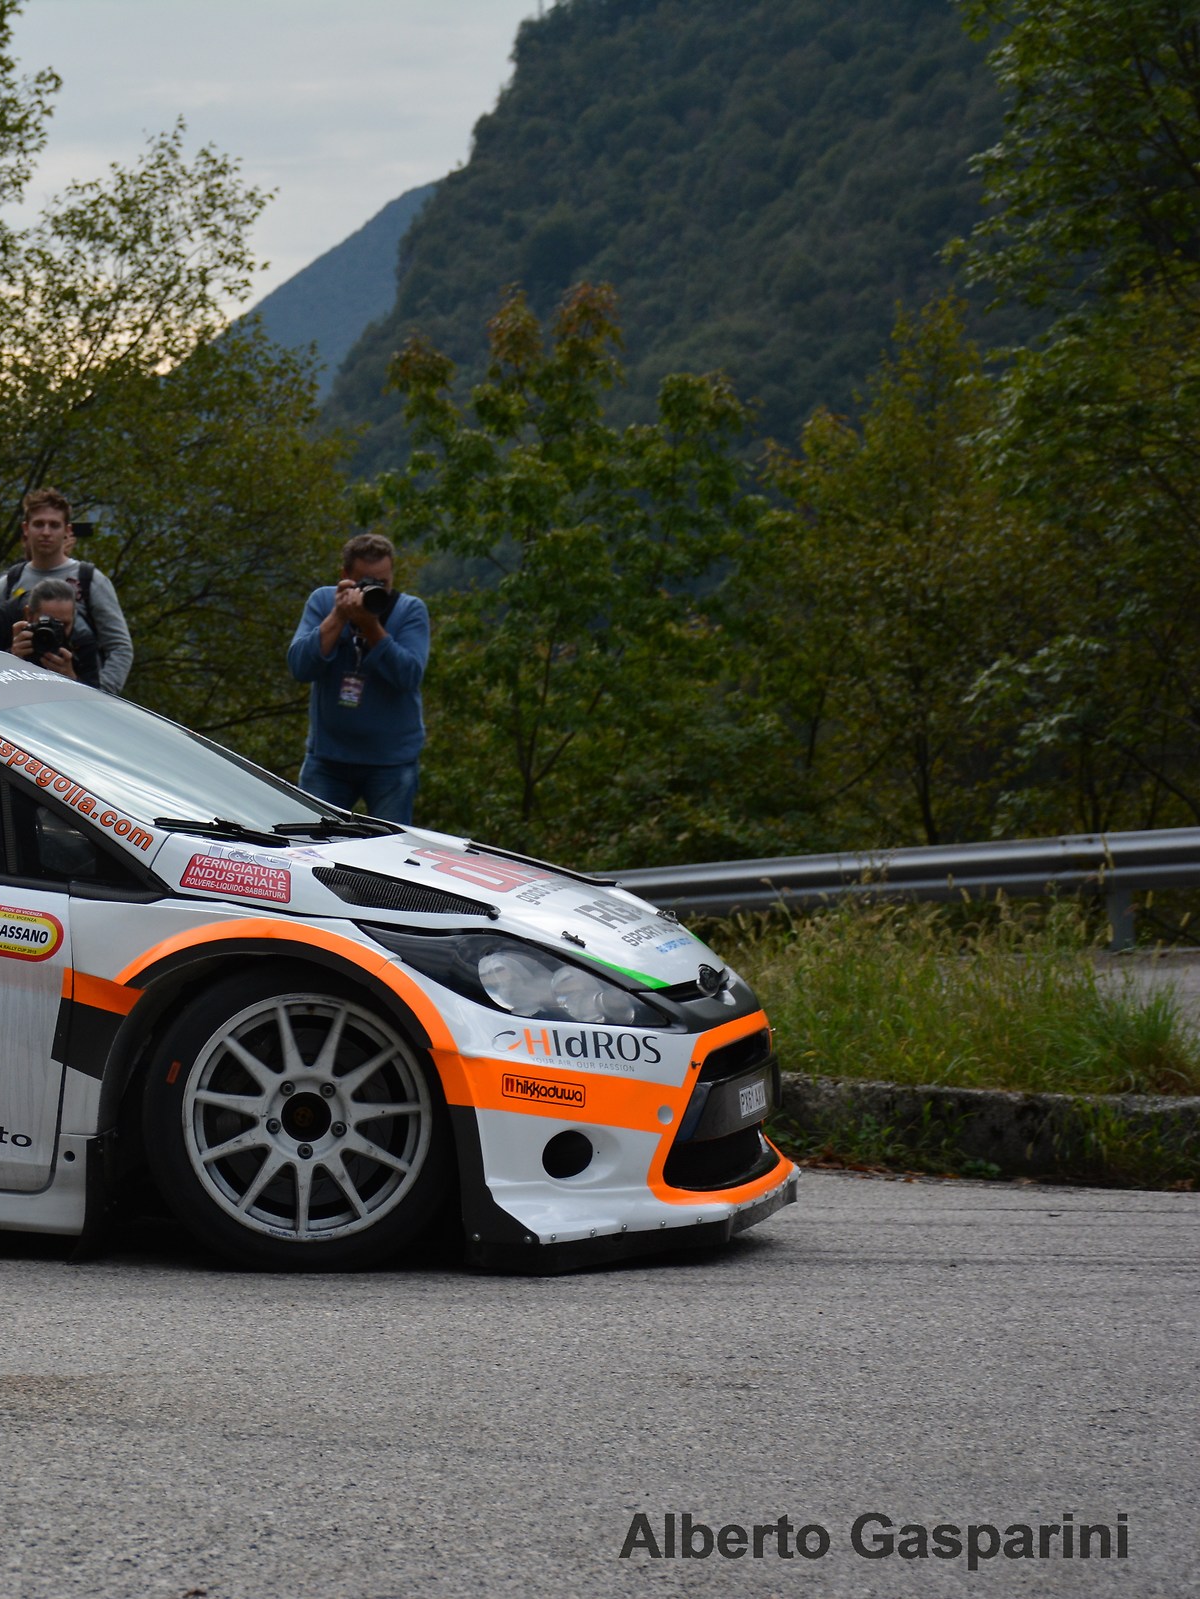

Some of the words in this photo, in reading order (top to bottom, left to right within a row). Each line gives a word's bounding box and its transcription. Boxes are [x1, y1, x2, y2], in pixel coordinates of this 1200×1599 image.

[189, 867, 287, 892] INDUSTRIALE
[195, 857, 286, 880] VERNICIATURA
[599, 1063, 635, 1072] PASSION
[515, 1079, 583, 1102] hikkaduwa
